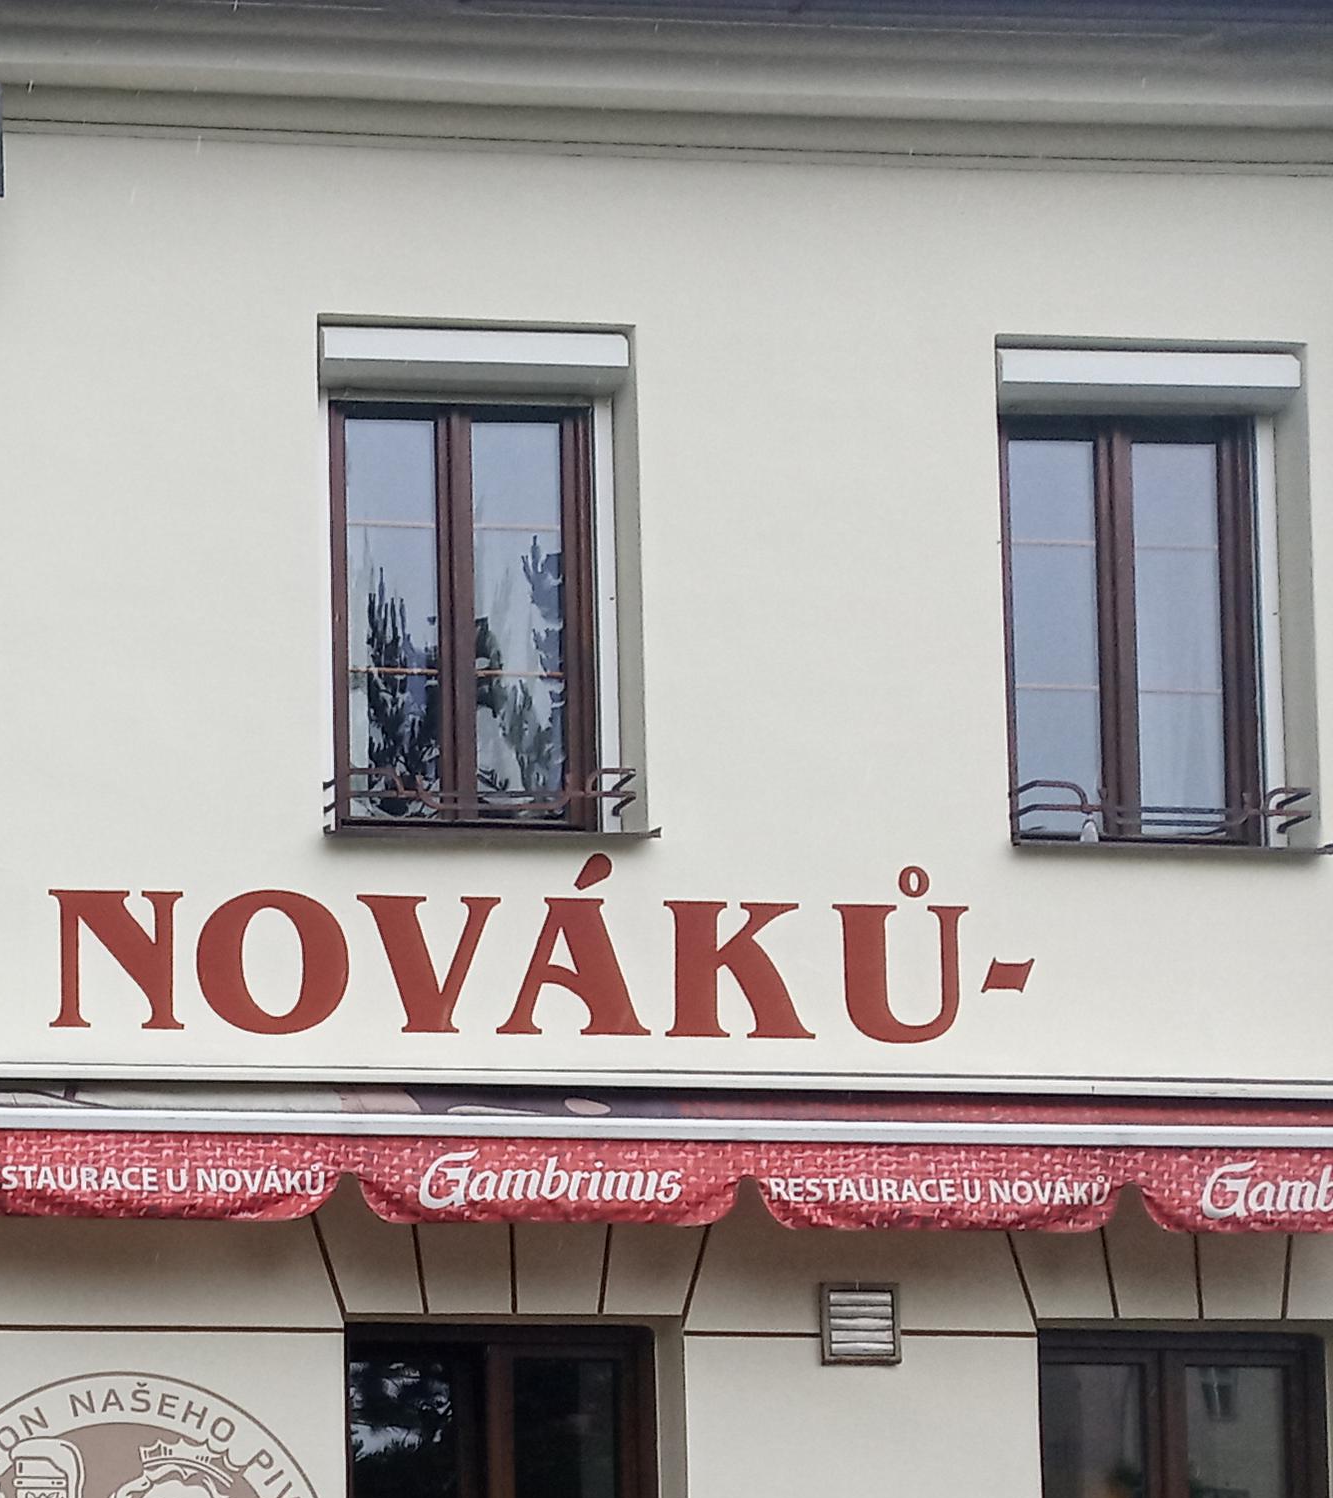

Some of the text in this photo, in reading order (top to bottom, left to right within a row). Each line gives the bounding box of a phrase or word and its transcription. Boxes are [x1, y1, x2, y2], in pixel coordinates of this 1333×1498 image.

[166, 1168, 188, 1193] U
[196, 1164, 326, 1196] NOVÁKŮ
[417, 1148, 683, 1210] Gambrinus
[767, 1174, 1112, 1207] RESTAURACE U NOVÁKŮ
[68, 1382, 237, 1445] NAŠEHO
